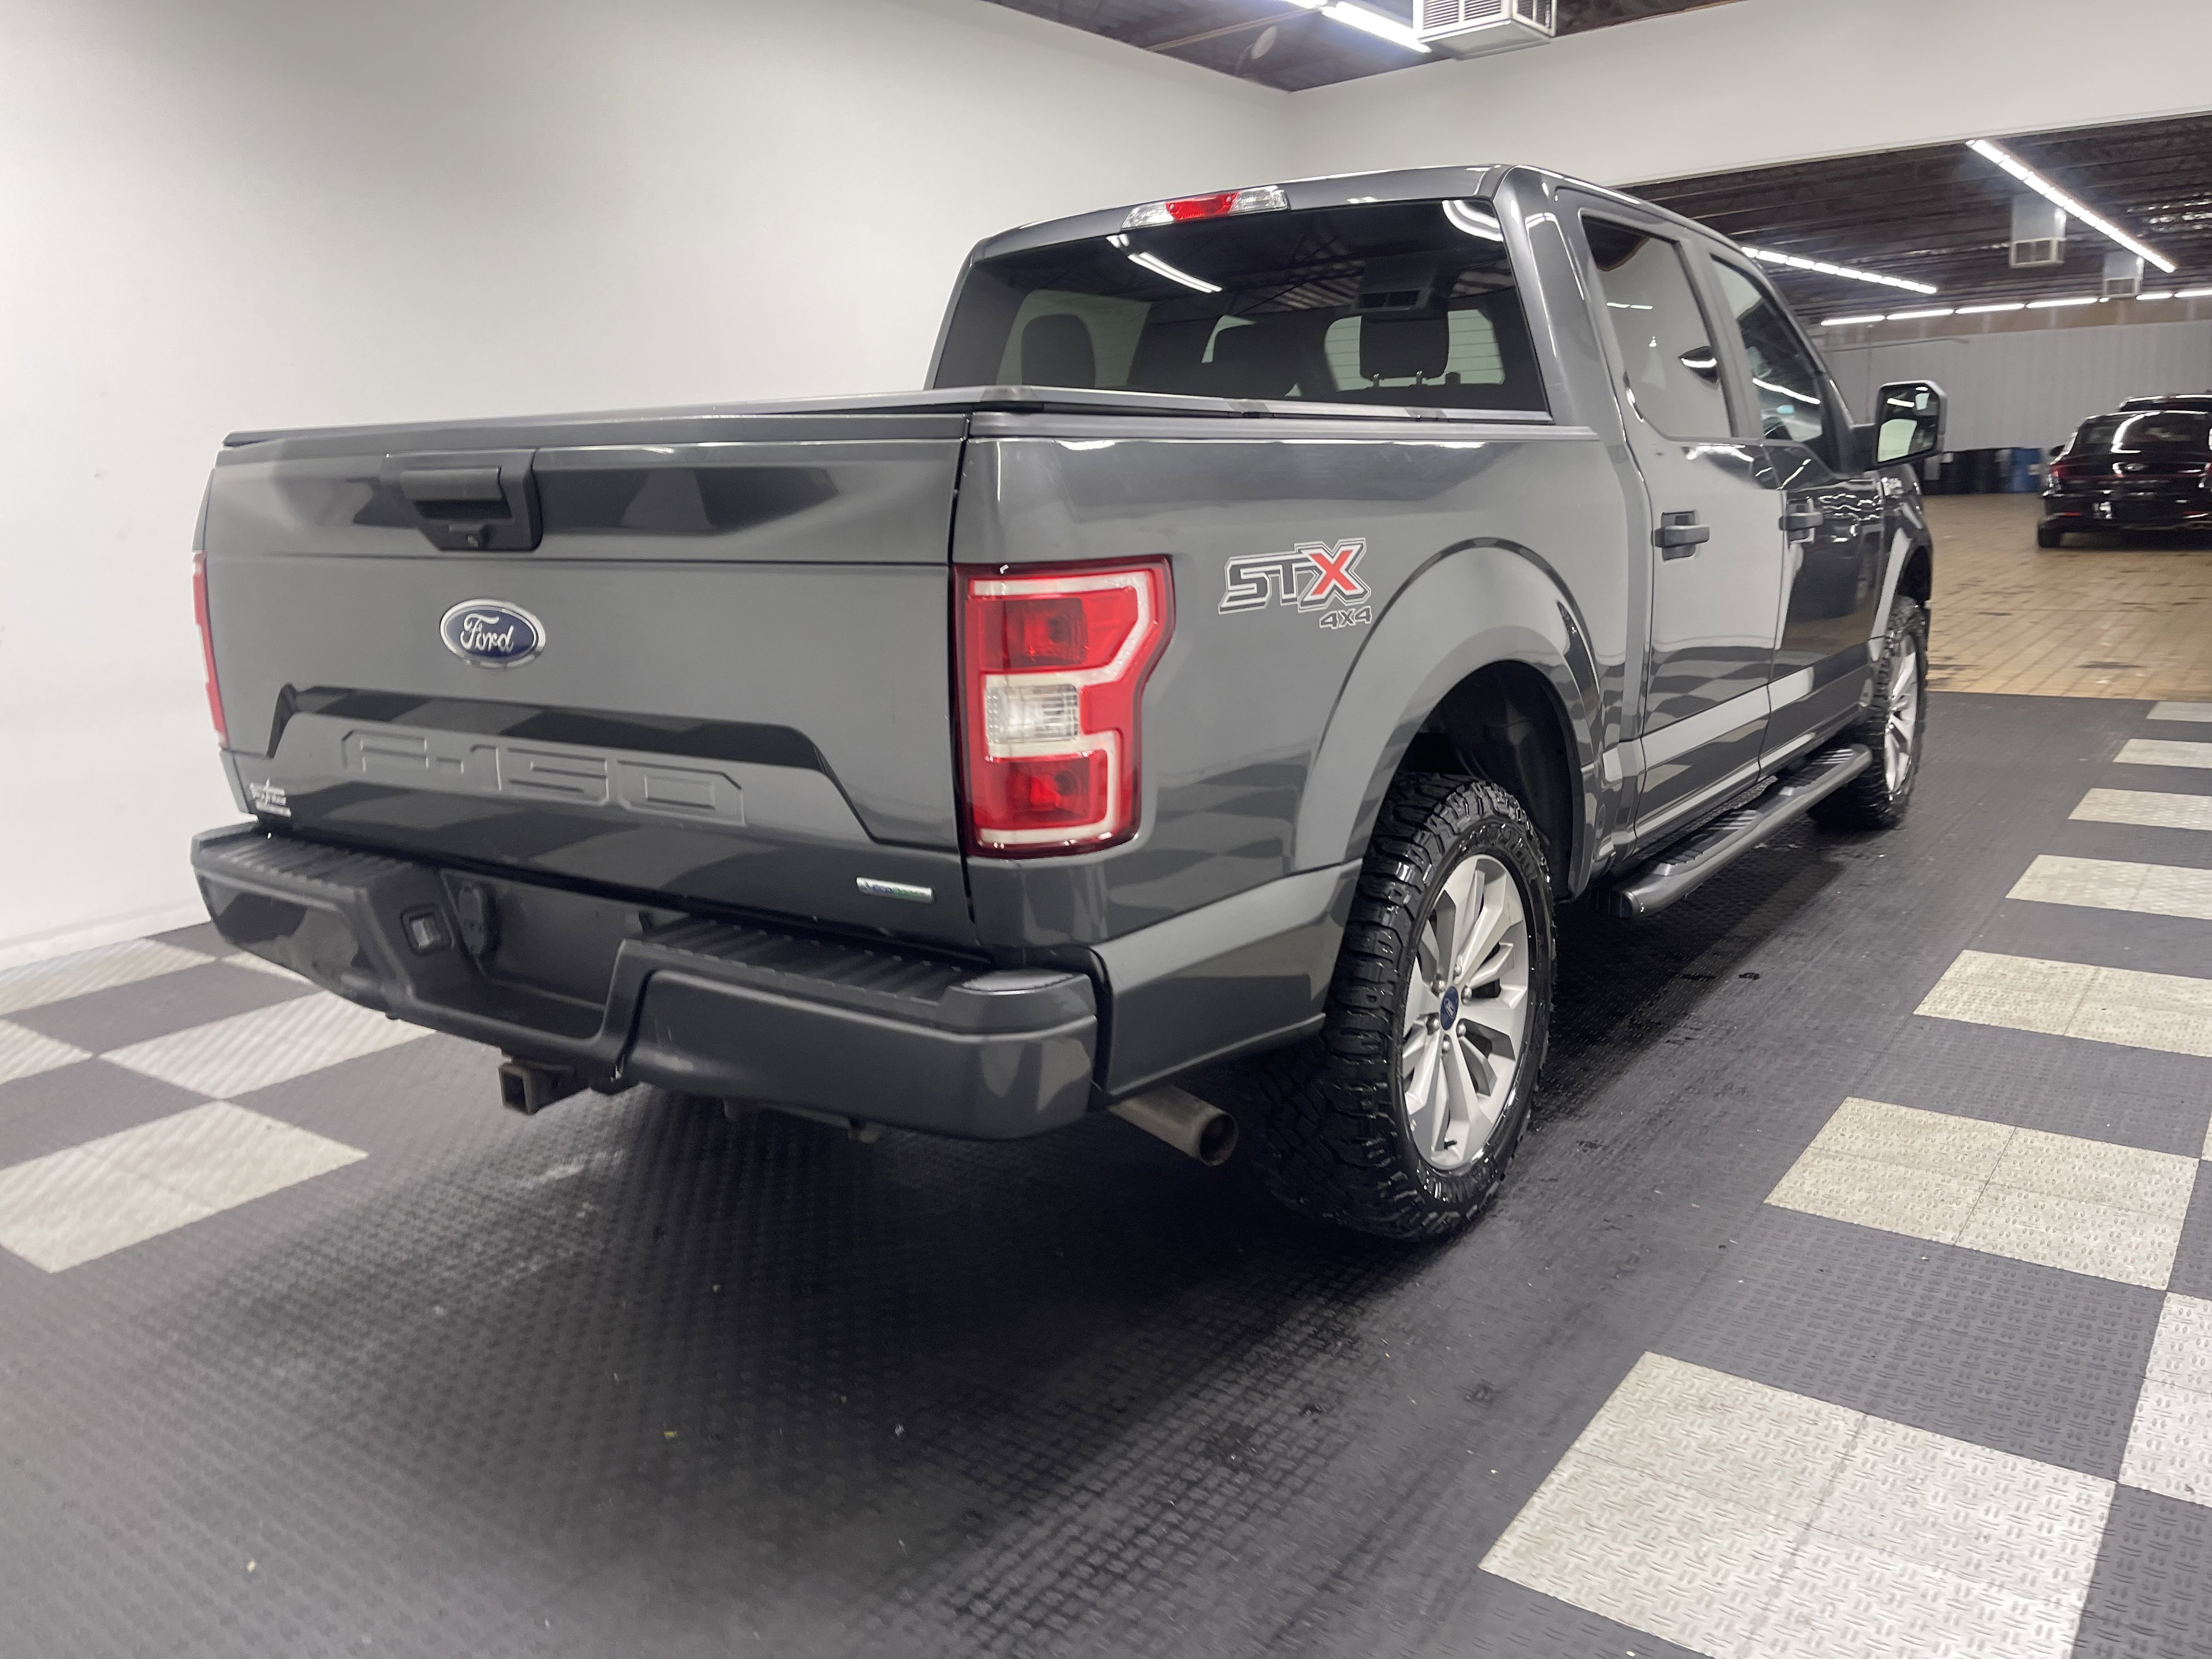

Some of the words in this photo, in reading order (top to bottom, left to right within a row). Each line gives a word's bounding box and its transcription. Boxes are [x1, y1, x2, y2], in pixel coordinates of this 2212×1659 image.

[1218, 537, 1372, 614] STX
[459, 612, 515, 653] Ford
[341, 729, 747, 826] F-150
